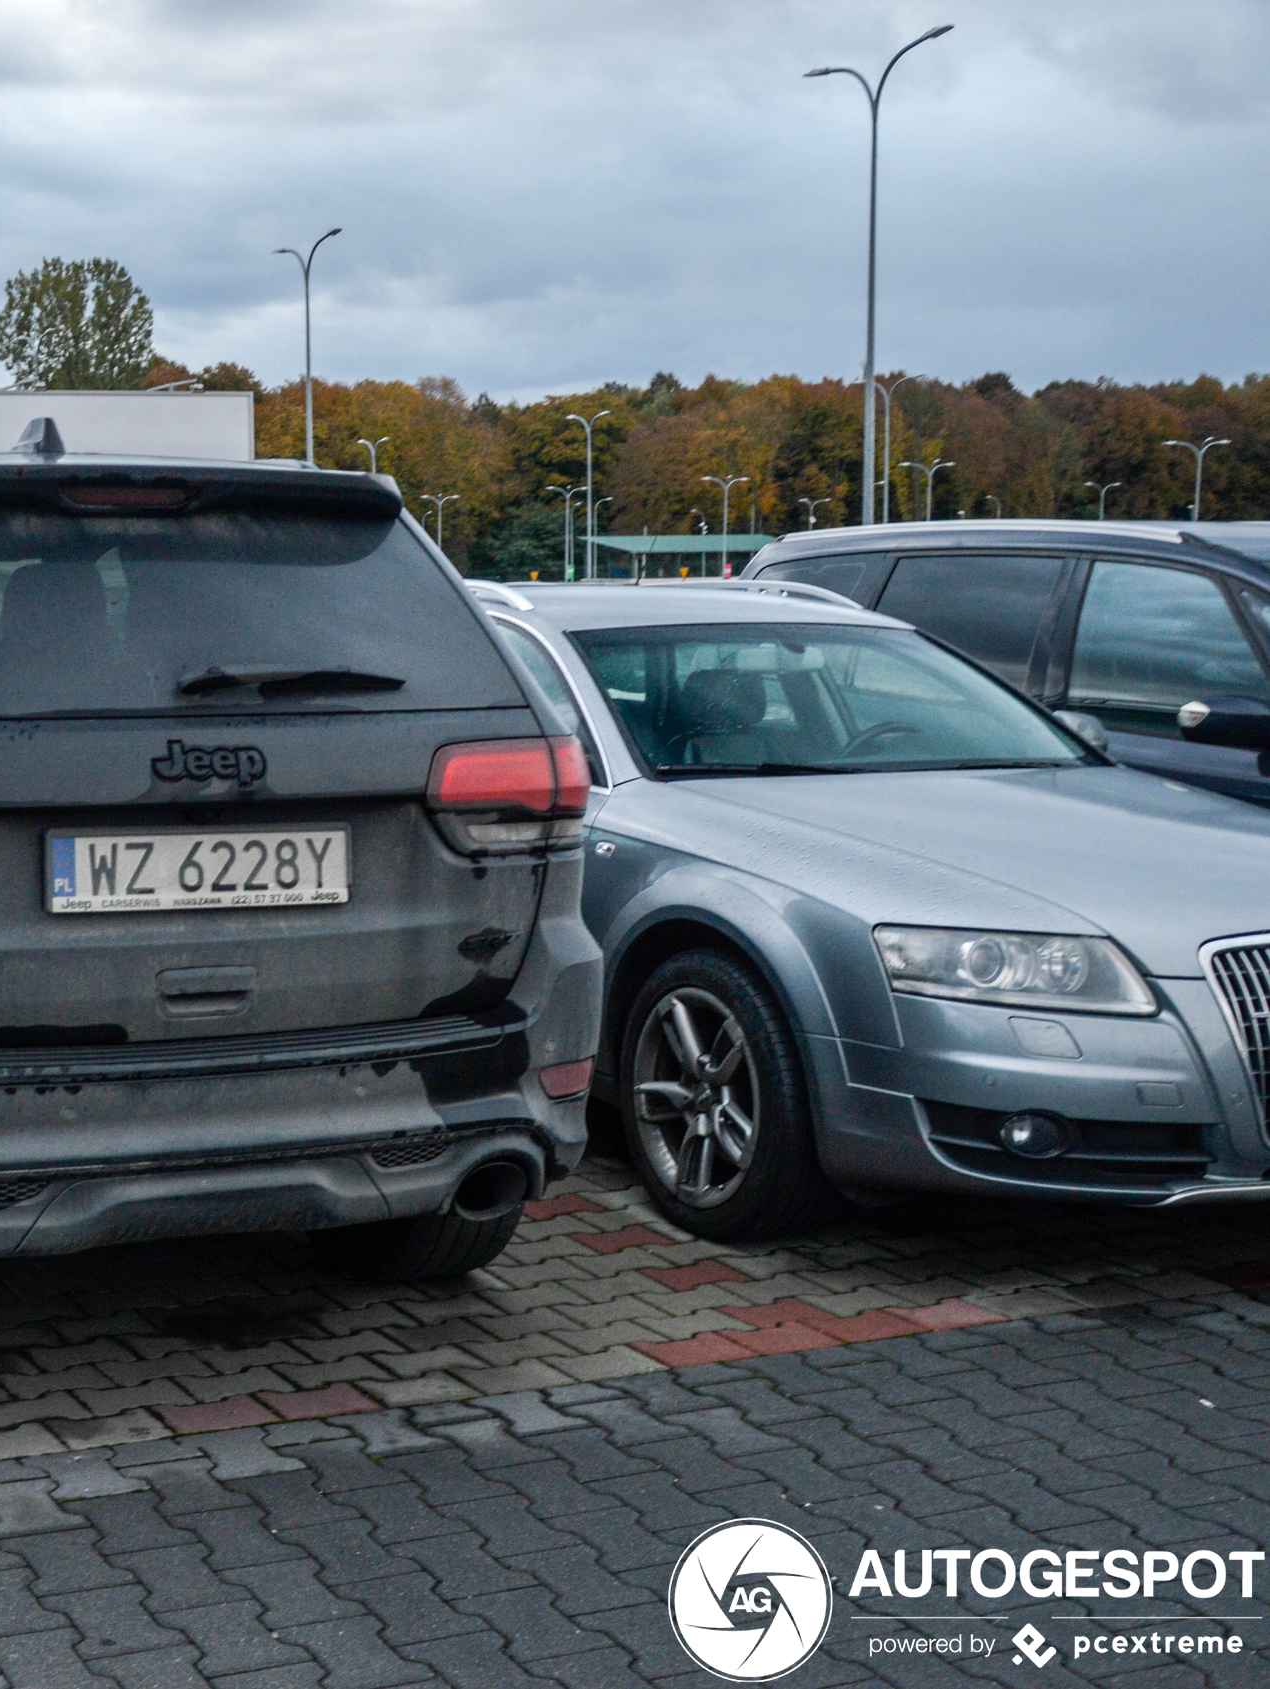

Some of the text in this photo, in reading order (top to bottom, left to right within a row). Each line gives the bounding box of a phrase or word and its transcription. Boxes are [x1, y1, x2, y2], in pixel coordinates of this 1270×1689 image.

[151, 739, 267, 788] Jeep
[88, 837, 333, 896] WZ 6228Y
[54, 877, 74, 893] PL
[61, 898, 92, 910] Jeep
[310, 890, 340, 902] Jeep
